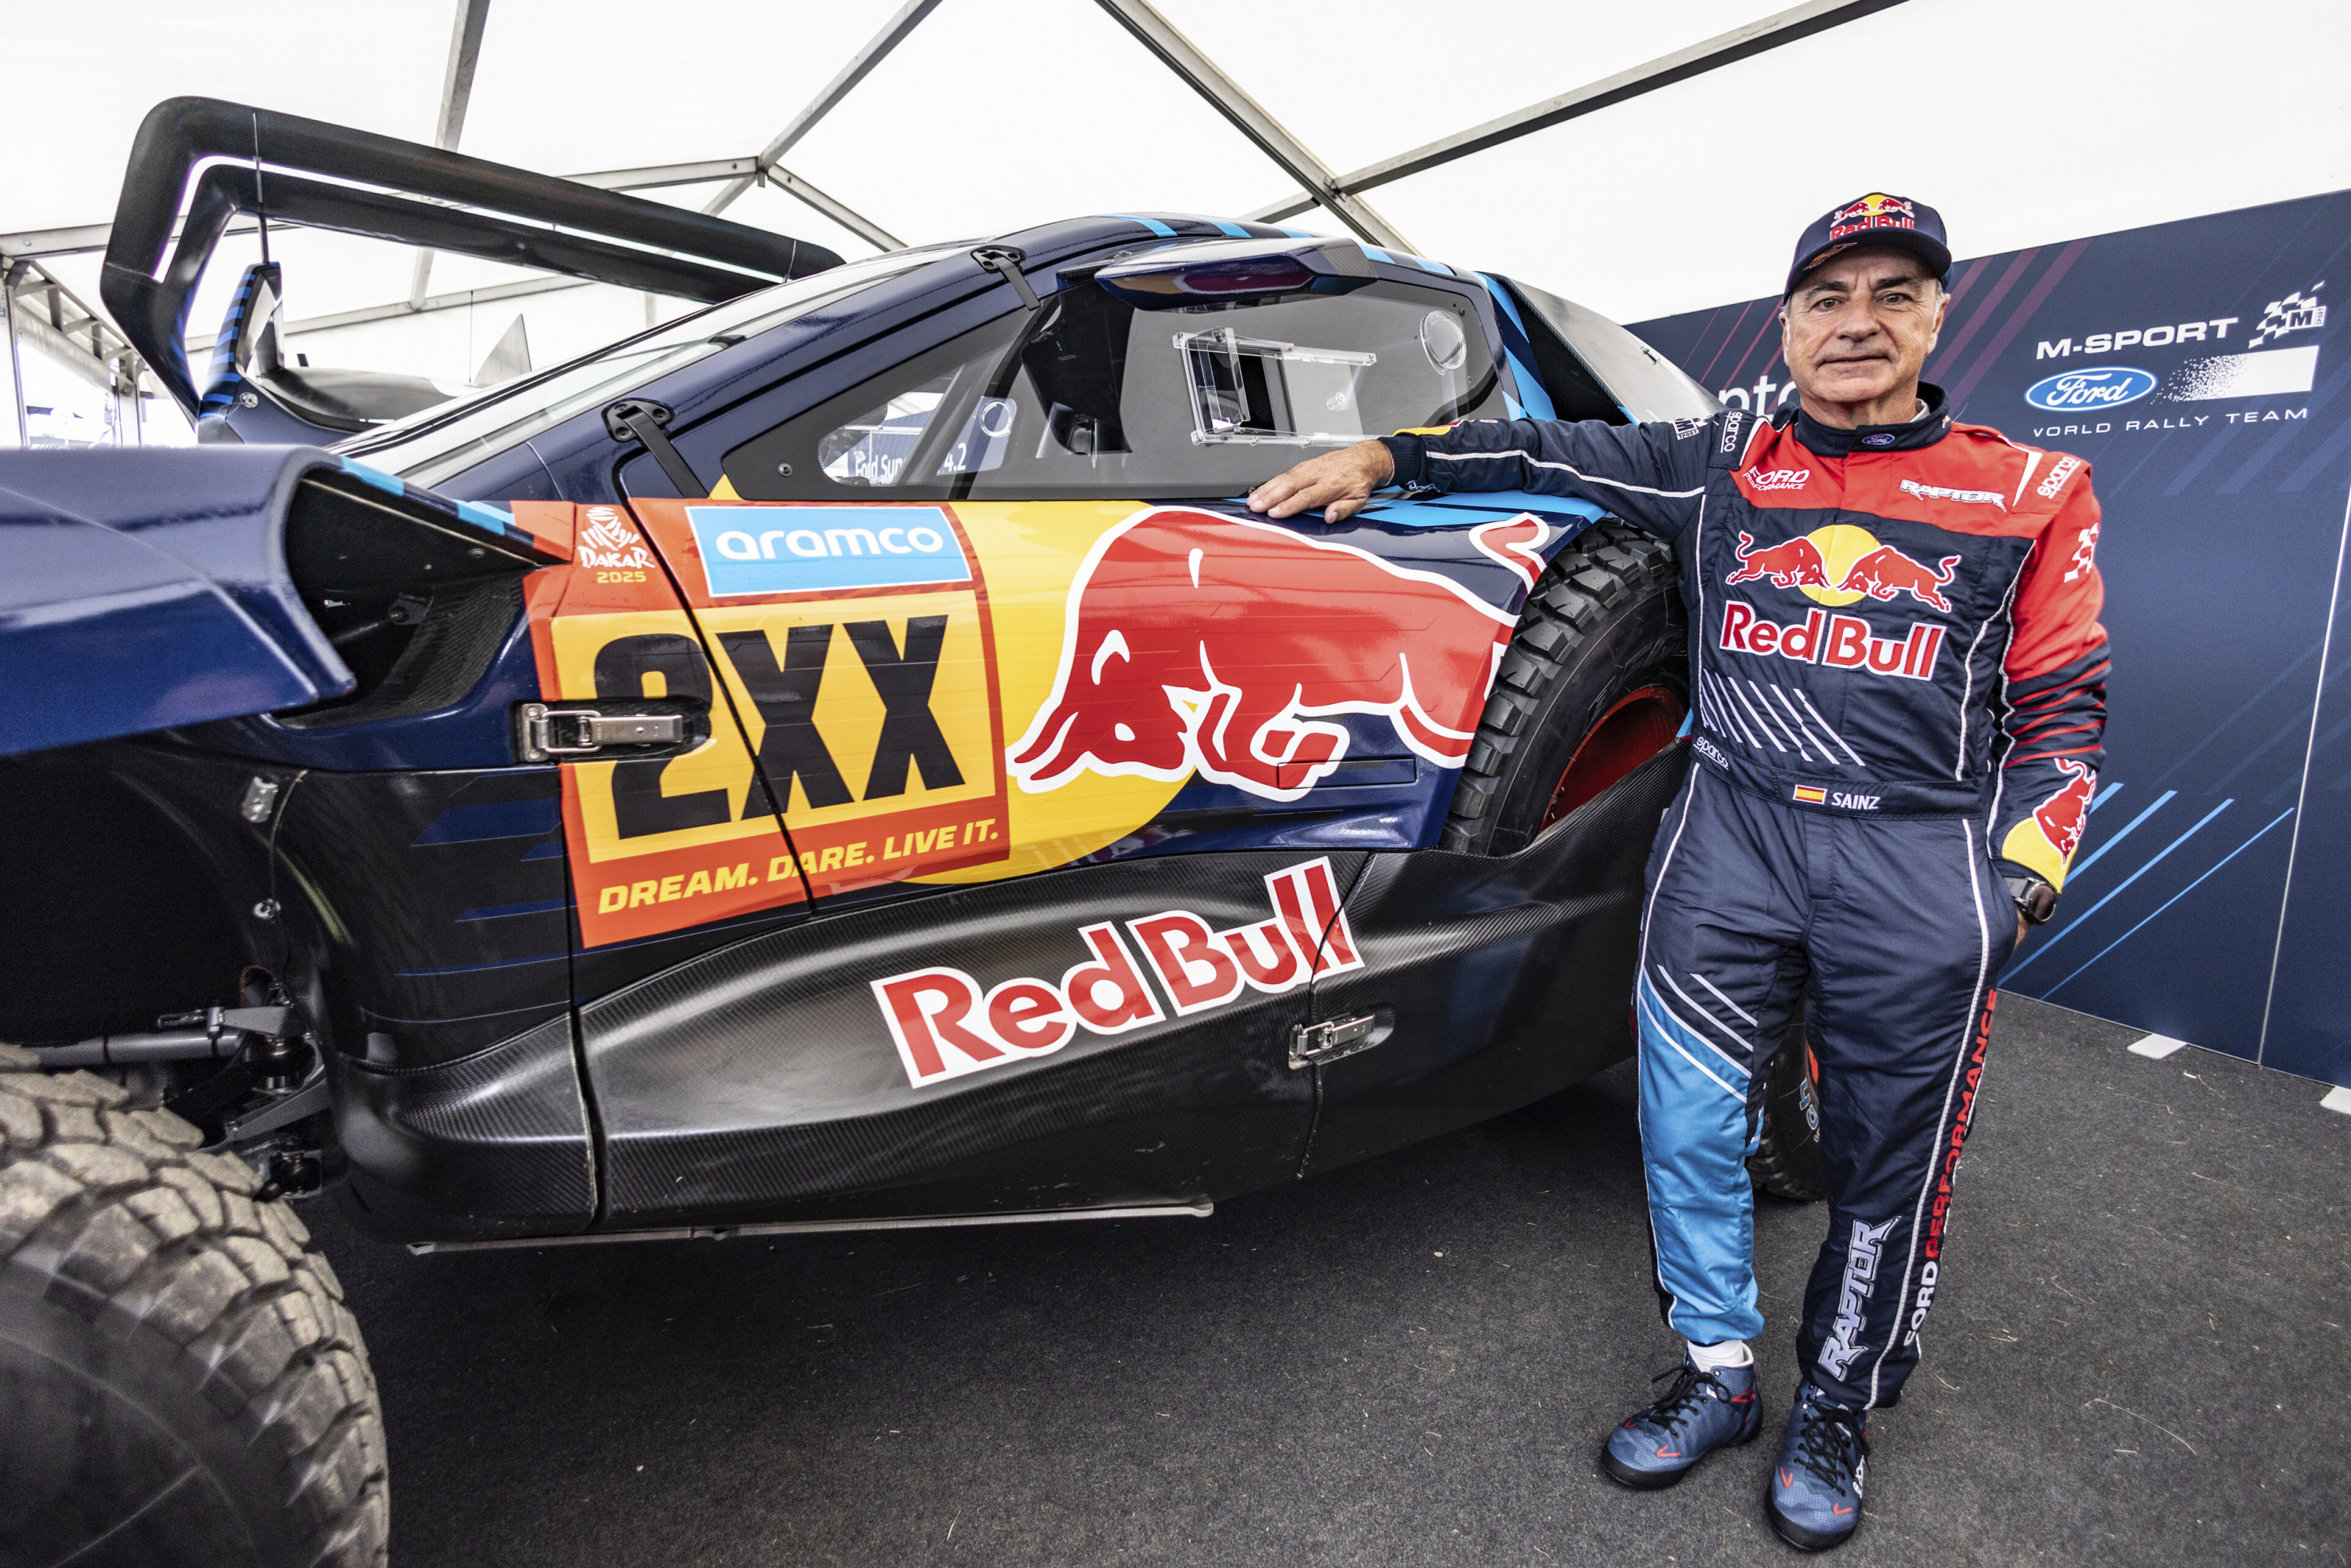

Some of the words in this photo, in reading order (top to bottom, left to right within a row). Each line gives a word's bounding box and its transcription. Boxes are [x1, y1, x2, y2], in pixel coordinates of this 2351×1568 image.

[1830, 216, 1873, 241] Red
[2036, 318, 2238, 359] M-SPORT
[2046, 372, 2128, 405] Ford
[1720, 412, 1743, 453] sparco
[2125, 416, 2209, 430] RALLY
[2225, 407, 2308, 424] TEAM
[1863, 434, 1888, 444] Ford
[2037, 456, 2077, 499] sparco
[1900, 479, 2007, 513] RAPTOR
[578, 546, 655, 568] DAKAR
[717, 527, 942, 561] aramco
[597, 571, 647, 583] 2025
[1720, 601, 1827, 663] Red
[1823, 615, 1946, 681] Bull
[1693, 736, 1729, 771] sparco
[1831, 792, 1881, 811] SAINZ
[597, 864, 758, 914] DREAM.
[767, 841, 875, 882] DARE.
[883, 828, 956, 862] LIVE
[961, 818, 999, 844] IT.
[870, 920, 1166, 1088] Red
[1125, 856, 1365, 1017] Bull
[1903, 1261, 1939, 1347] FORD
[1925, 989, 1997, 1258] PERFORMANCE
[1818, 1215, 1902, 1381] RAPTOR
